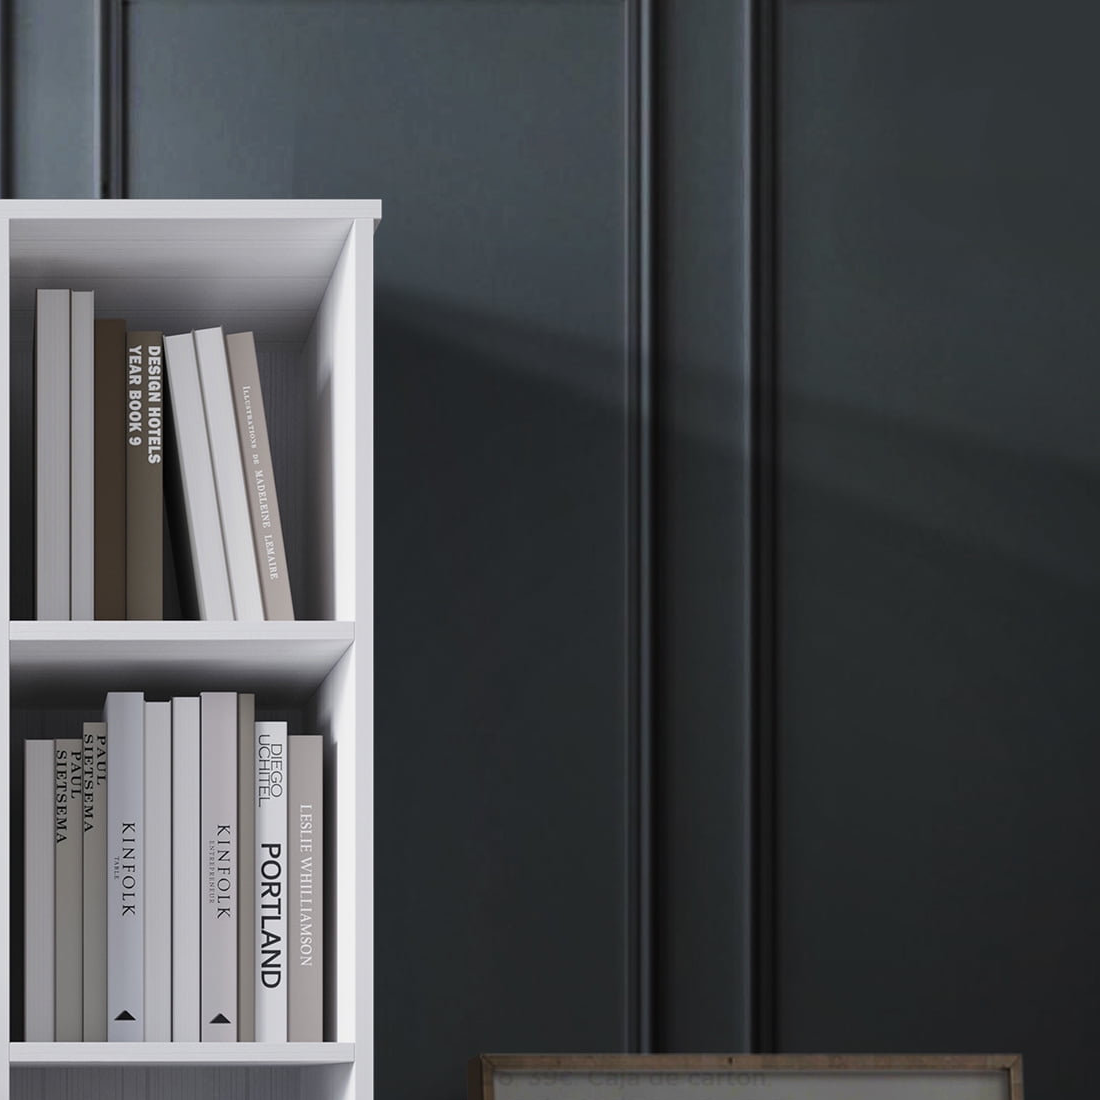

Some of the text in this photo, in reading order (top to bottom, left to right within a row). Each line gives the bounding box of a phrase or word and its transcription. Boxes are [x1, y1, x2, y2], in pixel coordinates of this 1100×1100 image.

[129, 345, 142, 446] YEAR BOOK 9
[148, 345, 162, 464] DESIGN HOTELS
[254, 470, 272, 528] MADELEINE
[264, 534, 278, 580] LEMAIRE
[56, 750, 68, 844] SIETSEMA
[70, 751, 82, 799] PAUL
[84, 734, 94, 833] SIETSEMA
[96, 735, 106, 785] PAUL
[258, 734, 270, 808] UCHITEL
[271, 743, 283, 798] DIEGO
[122, 822, 136, 916] KINFOLK
[217, 824, 230, 918] KINFOLK
[300, 804, 312, 967] LESLIE WHILLIAMSON
[261, 844, 282, 989] PORTLAND
